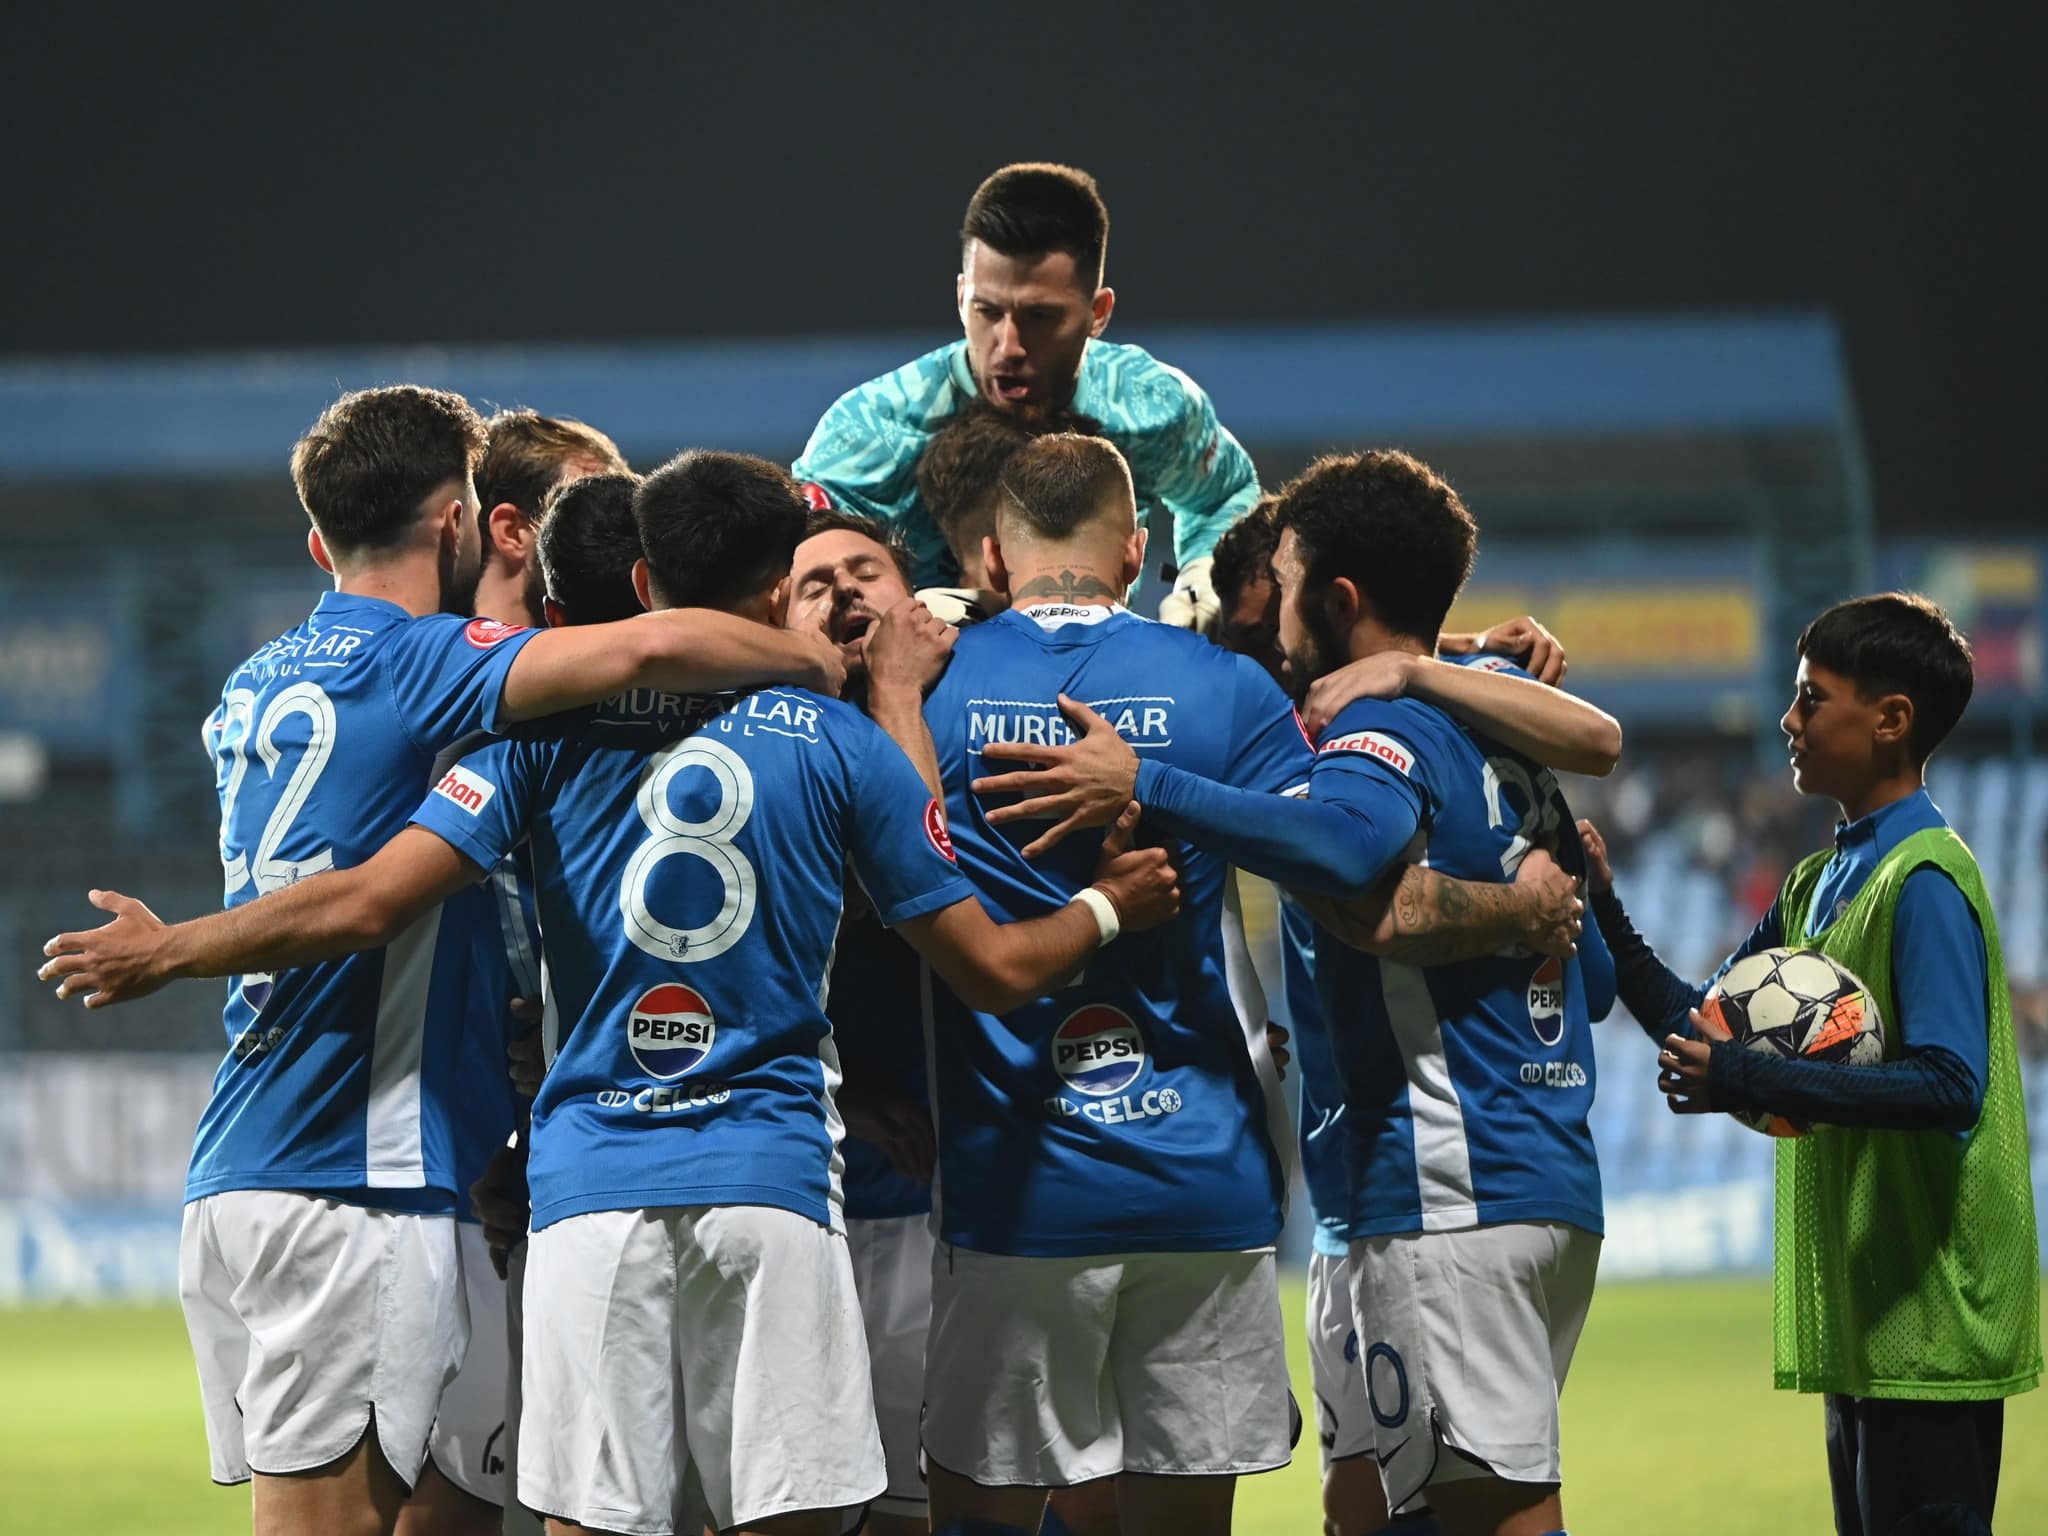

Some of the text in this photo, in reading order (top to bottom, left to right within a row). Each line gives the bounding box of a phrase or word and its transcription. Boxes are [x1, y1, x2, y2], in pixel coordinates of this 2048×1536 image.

[1061, 608, 1091, 617] PRO
[619, 736, 757, 963] 8
[632, 1018, 710, 1044] PEPSI
[1058, 1037, 1140, 1064] PEPSI
